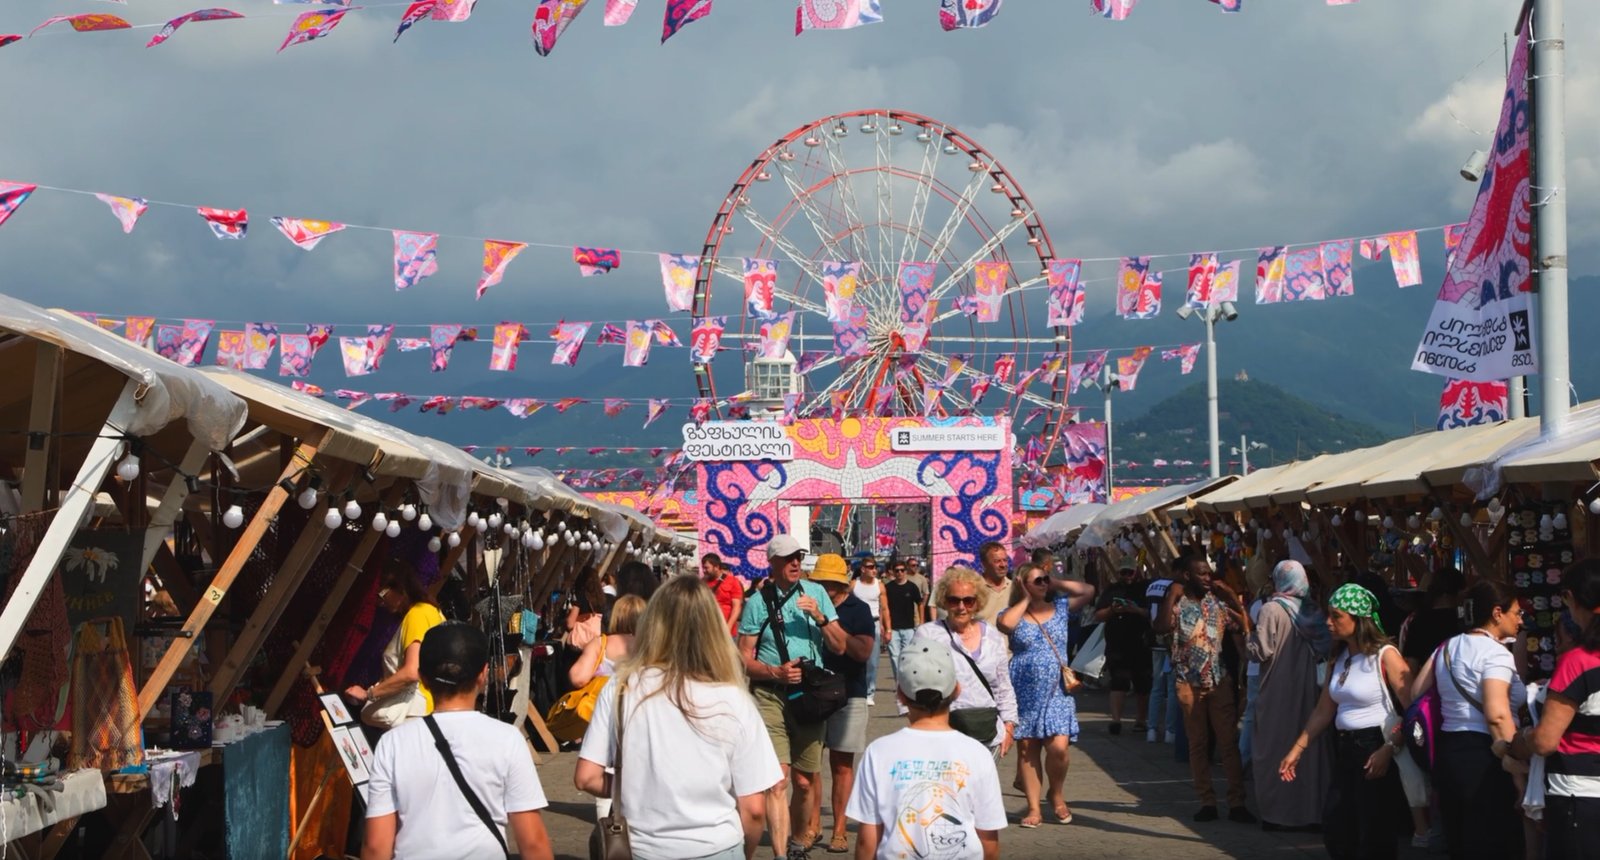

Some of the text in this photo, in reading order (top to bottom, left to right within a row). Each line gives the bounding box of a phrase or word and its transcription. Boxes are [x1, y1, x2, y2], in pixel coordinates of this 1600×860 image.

[686, 426, 782, 440] ზაფხულის
[946, 433, 976, 441] STARTS
[977, 433, 999, 441] HERE
[686, 443, 791, 457] ფესტივალი
